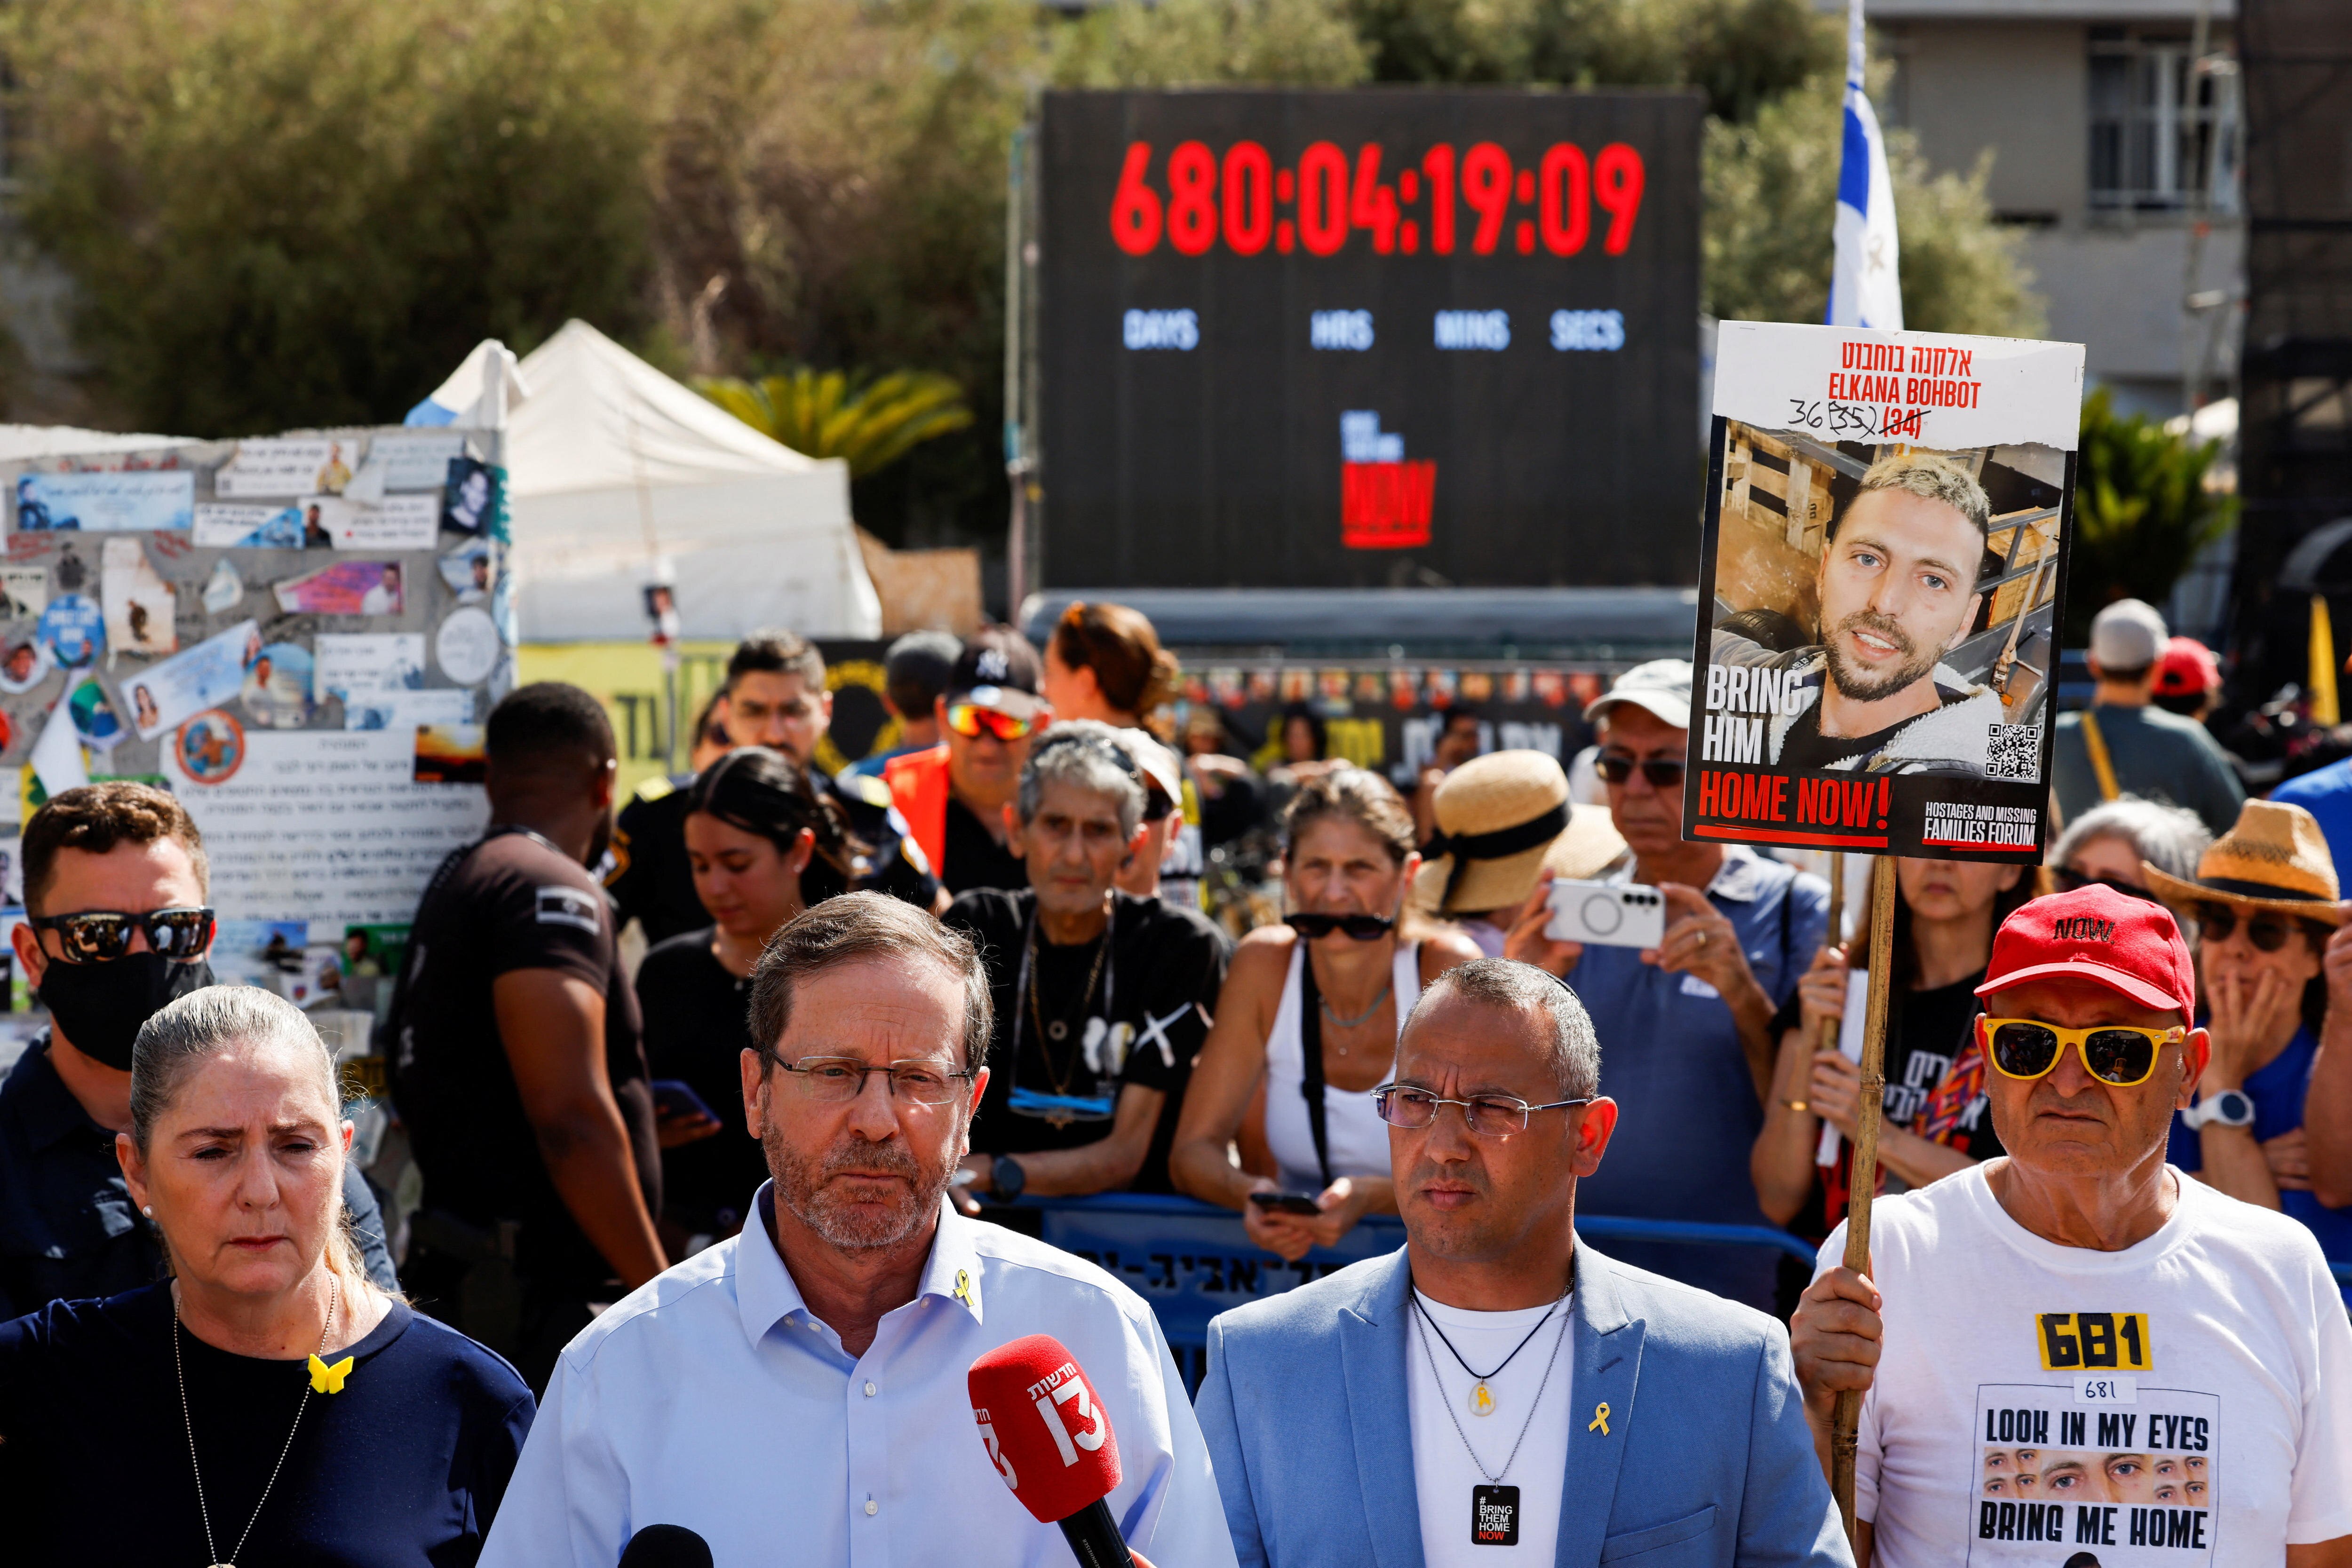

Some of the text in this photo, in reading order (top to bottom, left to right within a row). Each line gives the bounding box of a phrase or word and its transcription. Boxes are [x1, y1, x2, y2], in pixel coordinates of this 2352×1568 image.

[1109, 139, 1645, 258] 680:04:19:09
[1123, 308, 1625, 352] DAYS HRS MINS SECS
[1842, 342, 1971, 377] אלקנה בוחבוט
[1829, 373, 1981, 409] ELKANA BOHBOT
[1788, 399, 1823, 428] 36
[1706, 664, 1803, 715] BRING
[1702, 715, 1763, 764] HIM
[1699, 770, 1893, 830] HOME NOW!
[1925, 801, 2037, 824] HOSTAGES AND MISSING
[1924, 817, 2036, 846] FAMILIES FORUM
[2041, 1313, 2142, 1368] 681
[1026, 1362, 1077, 1401] חדשות
[2085, 1380, 2116, 1399] 681
[1036, 1375, 1106, 1468] 13
[1986, 1409, 2209, 1452] LOOK IN MY EYES
[977, 1423, 1018, 1490] 3
[1479, 1505, 1513, 1514] BRING
[1479, 1513, 1509, 1523] THEM
[1479, 1522, 1510, 1532] HOME
[1979, 1501, 2208, 1550] BRING ME HOME
[1478, 1531, 1505, 1540] NOW
